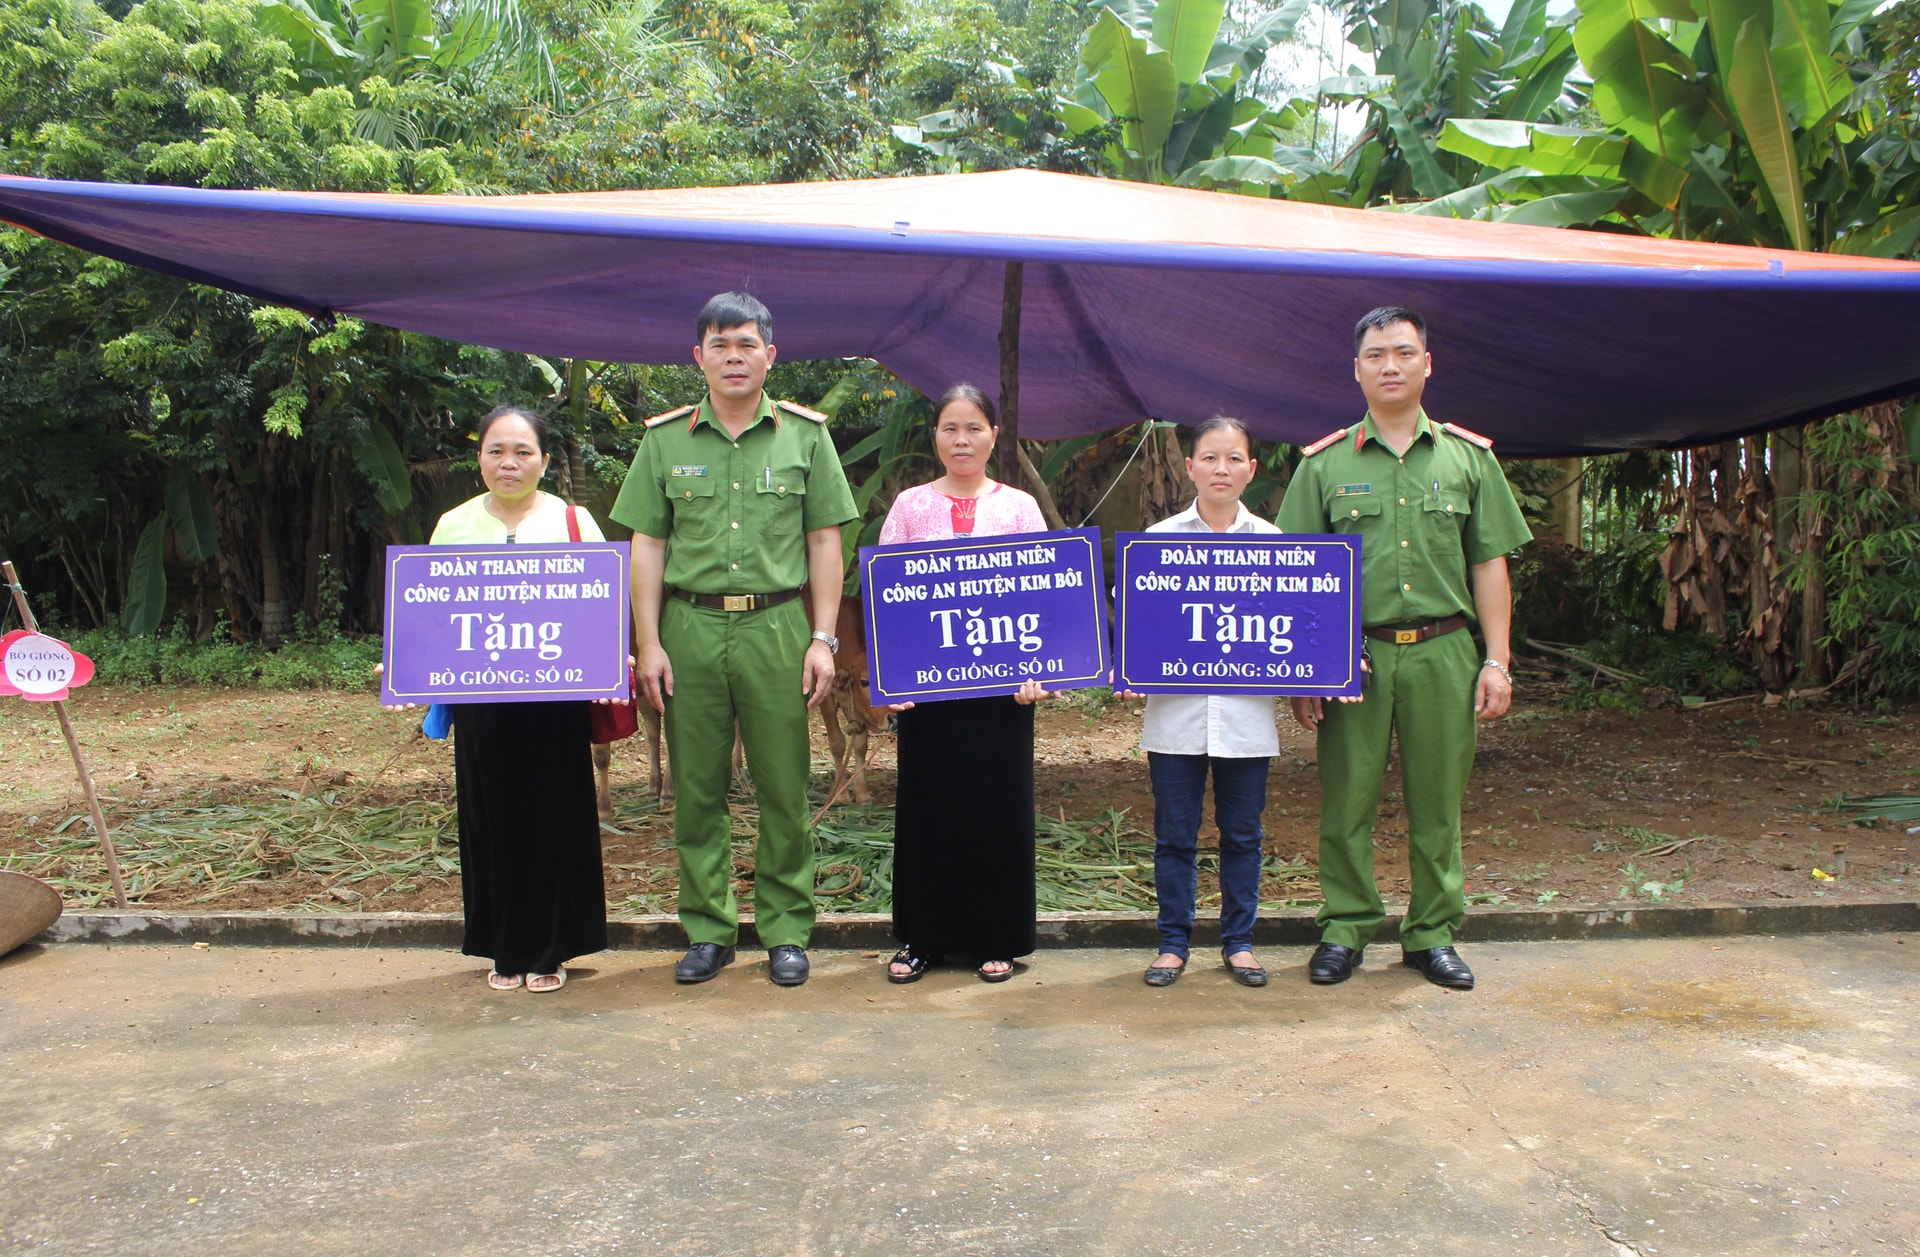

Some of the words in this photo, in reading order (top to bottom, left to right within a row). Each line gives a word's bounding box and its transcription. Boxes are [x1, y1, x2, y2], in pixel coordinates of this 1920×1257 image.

[429, 557, 478, 577] ĐOÀN
[482, 559, 540, 575] THANH
[544, 554, 585, 574] NIÊN
[905, 554, 951, 575] ĐOÀN
[955, 551, 1012, 571] THANH
[1017, 544, 1055, 566] NIÊN
[1161, 545, 1209, 565] ĐOÀN
[1213, 549, 1271, 565] THANH
[1275, 546, 1316, 566] NIÊN
[404, 583, 451, 603] CÔNG
[454, 586, 479, 602] AN
[483, 581, 541, 604] HUYỆN
[545, 584, 578, 599] KIM
[581, 579, 610, 599] BÔI
[883, 583, 928, 603] CÔNG
[932, 583, 955, 599] AN
[960, 574, 1016, 598] HUYỆN
[1020, 574, 1051, 591] KIM
[1055, 567, 1083, 588] BÔI
[1135, 571, 1182, 591] CÔNG
[1186, 575, 1210, 591] AN
[1214, 572, 1272, 596] HUYỆN
[1276, 576, 1309, 592] KIM
[1312, 572, 1340, 592] BÔI
[450, 612, 563, 661] Tặng
[930, 607, 1043, 656] Tặng
[1181, 603, 1293, 654] Tặng
[16, 665, 42, 682] SỐ
[47, 669, 66, 682] 02
[429, 667, 456, 686] BÒ
[460, 666, 530, 684] GIỐNG:
[535, 665, 560, 683] SỐ
[564, 668, 583, 682] 02
[916, 665, 942, 684] BÒ
[947, 661, 1014, 681] GIỐNG:
[1018, 657, 1042, 675] SỐ
[1047, 658, 1064, 673] 01
[1161, 658, 1187, 676] BÒ
[1192, 659, 1261, 677] GIỐNG:
[1266, 660, 1291, 677] SỐ
[1295, 664, 1314, 677] 03
